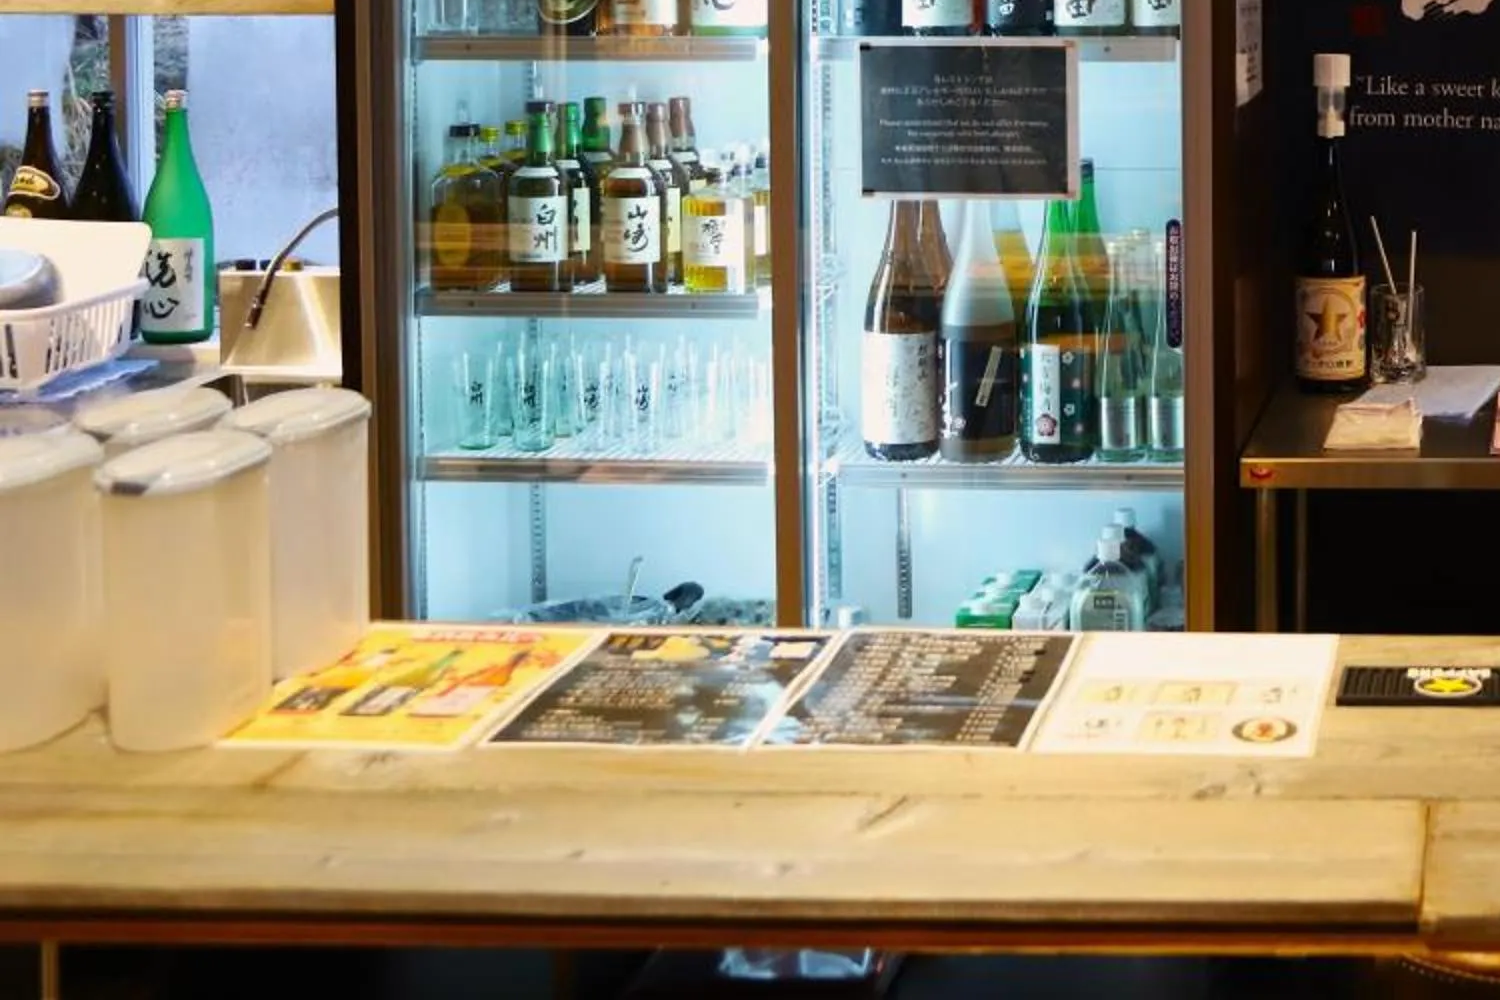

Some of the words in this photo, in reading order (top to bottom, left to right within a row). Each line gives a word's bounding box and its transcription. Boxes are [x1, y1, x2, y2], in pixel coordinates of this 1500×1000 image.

[1415, 83, 1425, 96] a
[1433, 83, 1485, 98] sweet
[1350, 106, 1396, 127] from
[1403, 108, 1472, 129] mother
[533, 204, 558, 251] 白州
[623, 205, 651, 251] 山崎
